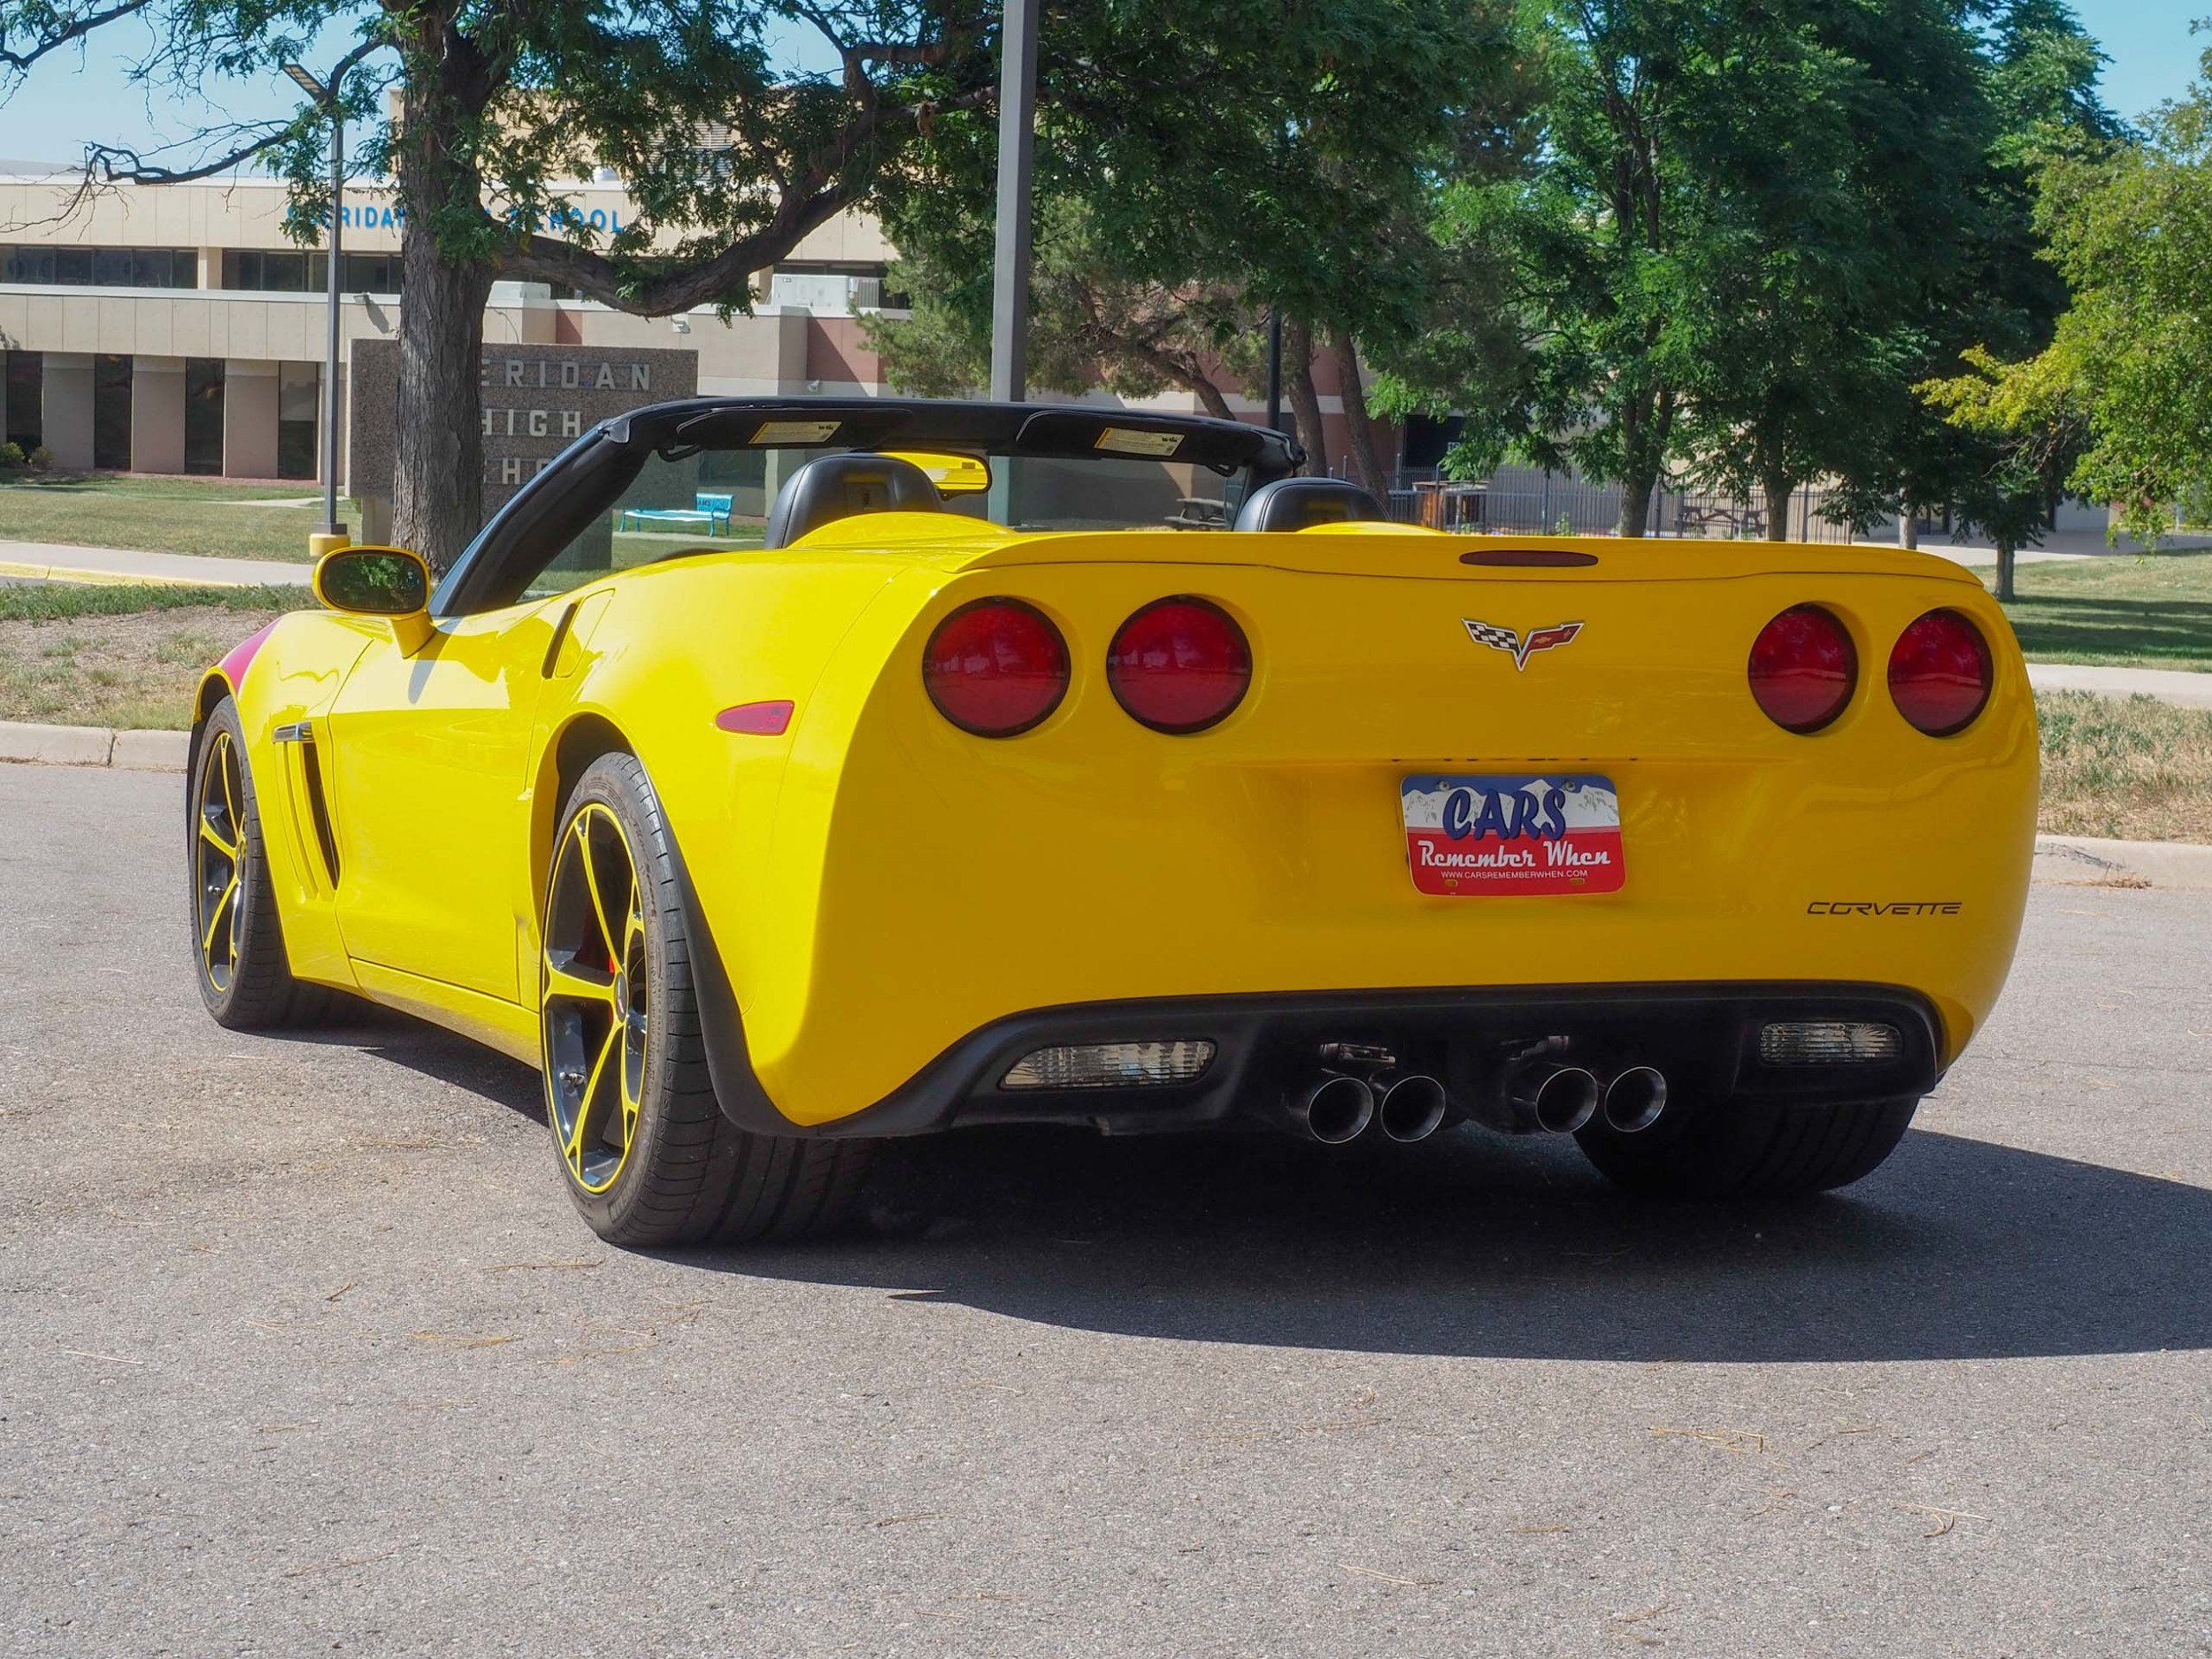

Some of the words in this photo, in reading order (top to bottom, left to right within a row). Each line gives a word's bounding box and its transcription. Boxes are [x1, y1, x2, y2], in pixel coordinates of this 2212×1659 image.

[481, 358, 650, 391] ERIDAN
[1442, 787, 1566, 841] CARS
[1417, 840, 1536, 867] Remember
[1543, 840, 1611, 866] When
[1440, 869, 1589, 879] WWW.CARSREMEMBERWHEN.COM
[1807, 902, 1962, 916] CORVETTE
